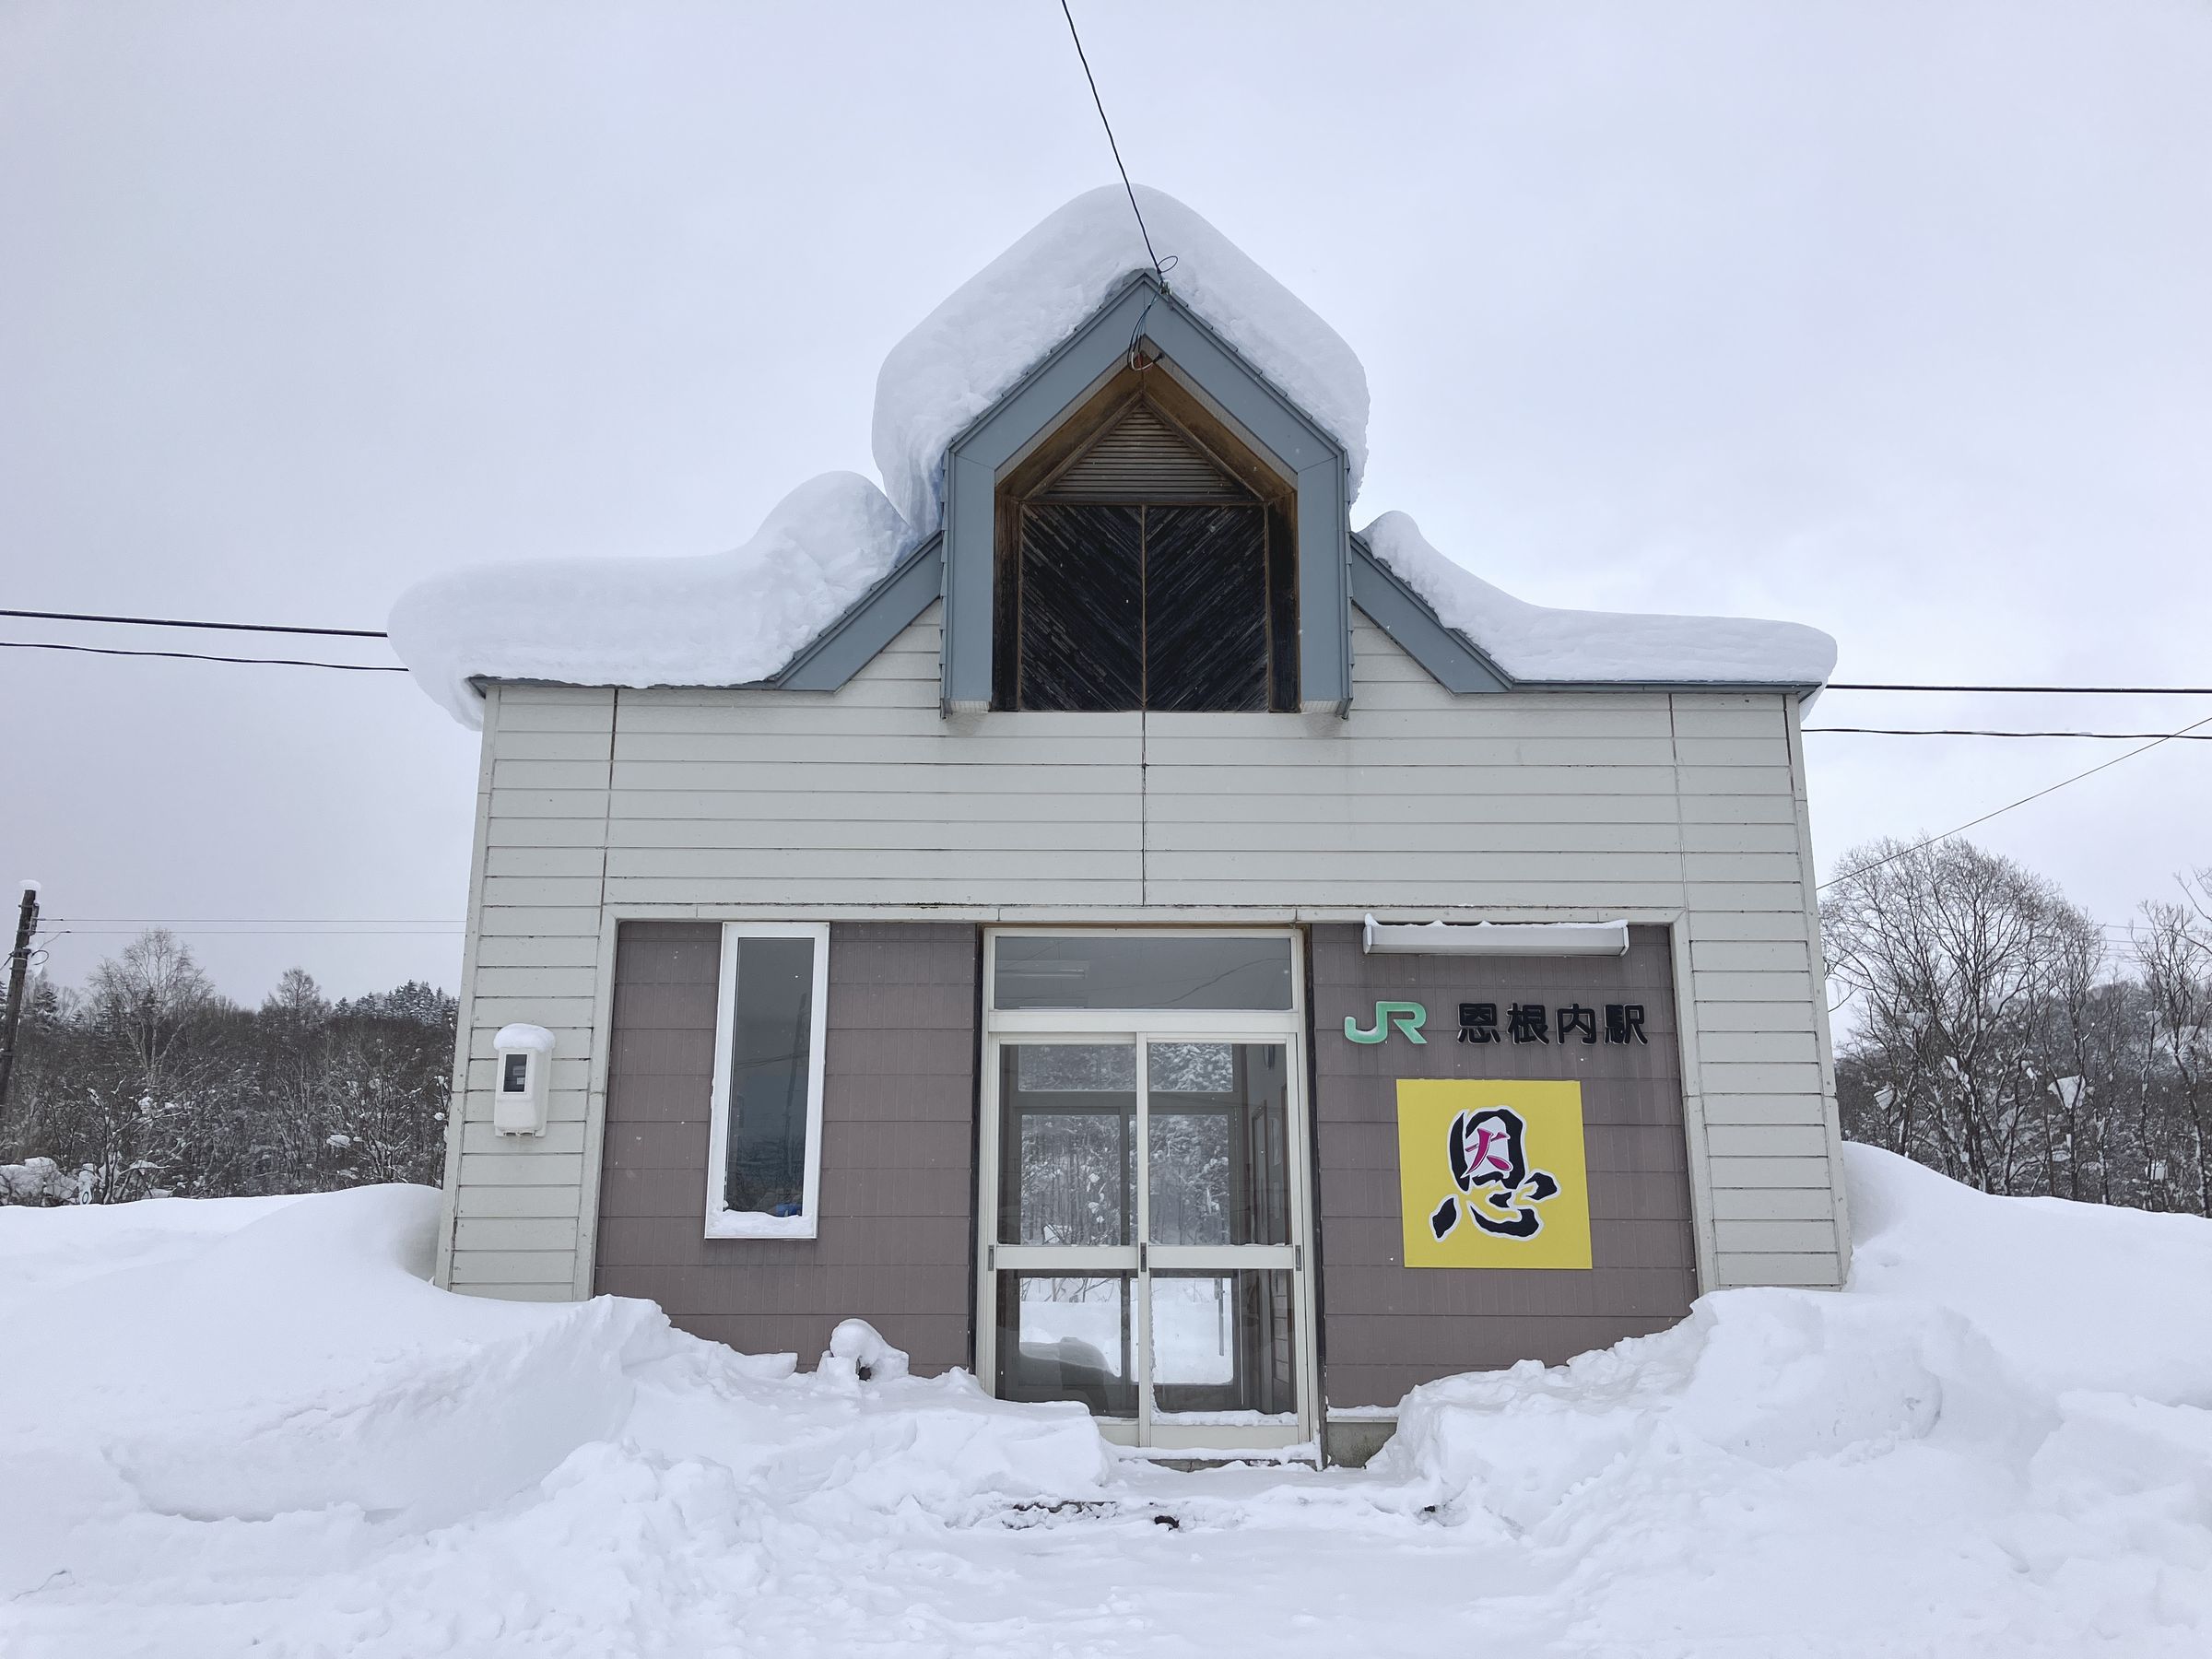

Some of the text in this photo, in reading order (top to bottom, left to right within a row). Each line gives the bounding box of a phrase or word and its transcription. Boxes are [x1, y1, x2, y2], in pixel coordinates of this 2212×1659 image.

[1344, 1001, 1648, 1045] JR 恩根内駅
[1430, 1106, 1560, 1241] 恩
